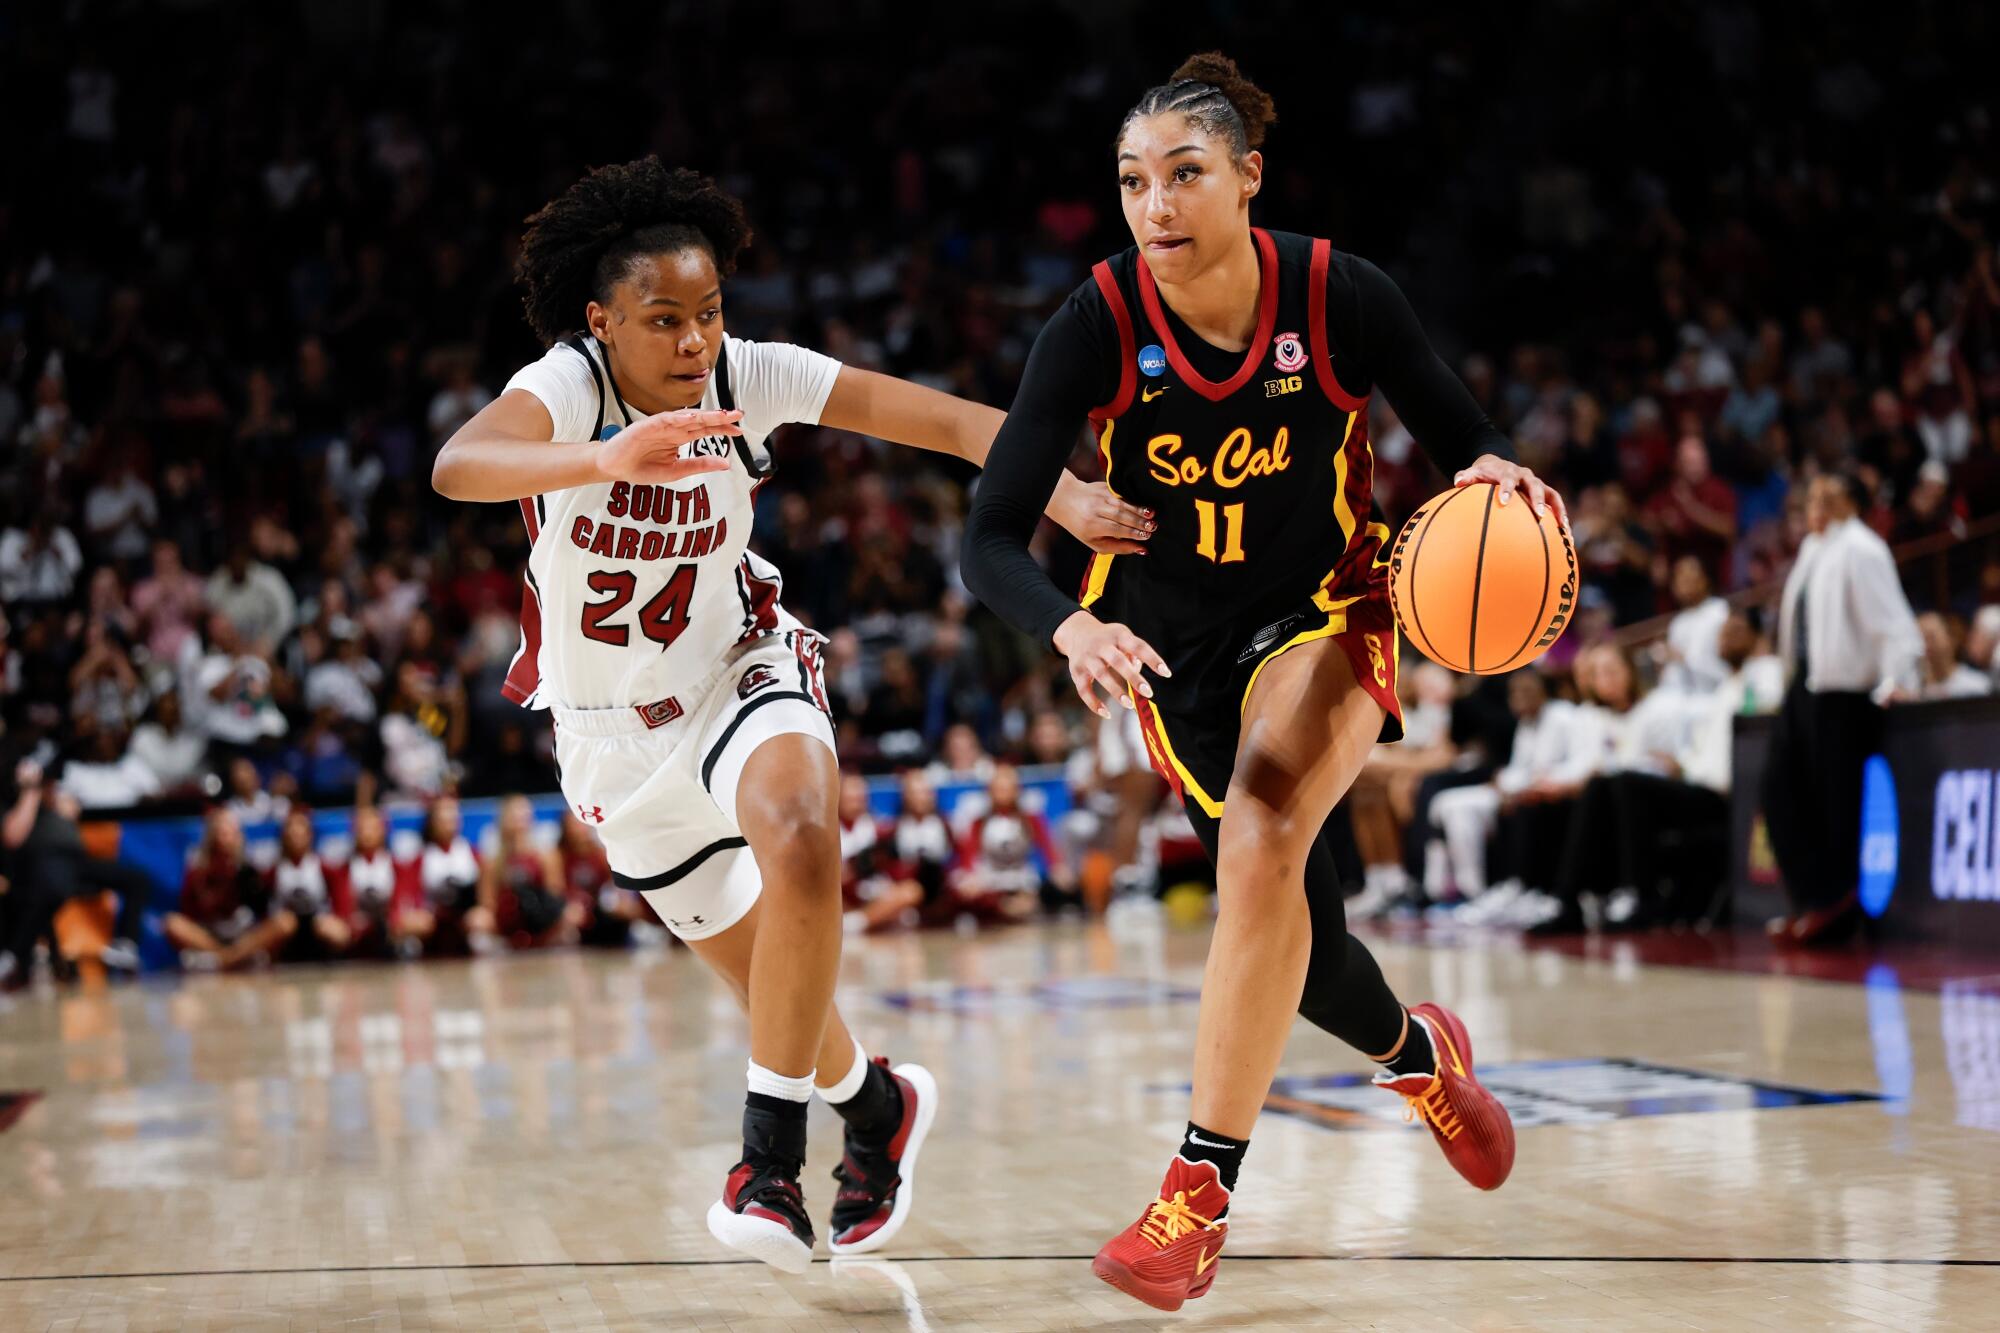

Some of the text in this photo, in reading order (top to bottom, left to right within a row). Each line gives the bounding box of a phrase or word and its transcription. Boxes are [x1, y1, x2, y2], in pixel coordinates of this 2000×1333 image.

[1147, 426, 1292, 489] So Cal
[606, 480, 711, 525] SOUTH
[1194, 498, 1245, 565] 11
[570, 515, 727, 561] CAROLINA
[580, 563, 698, 654] 24
[1534, 526, 1577, 648] Wilson
